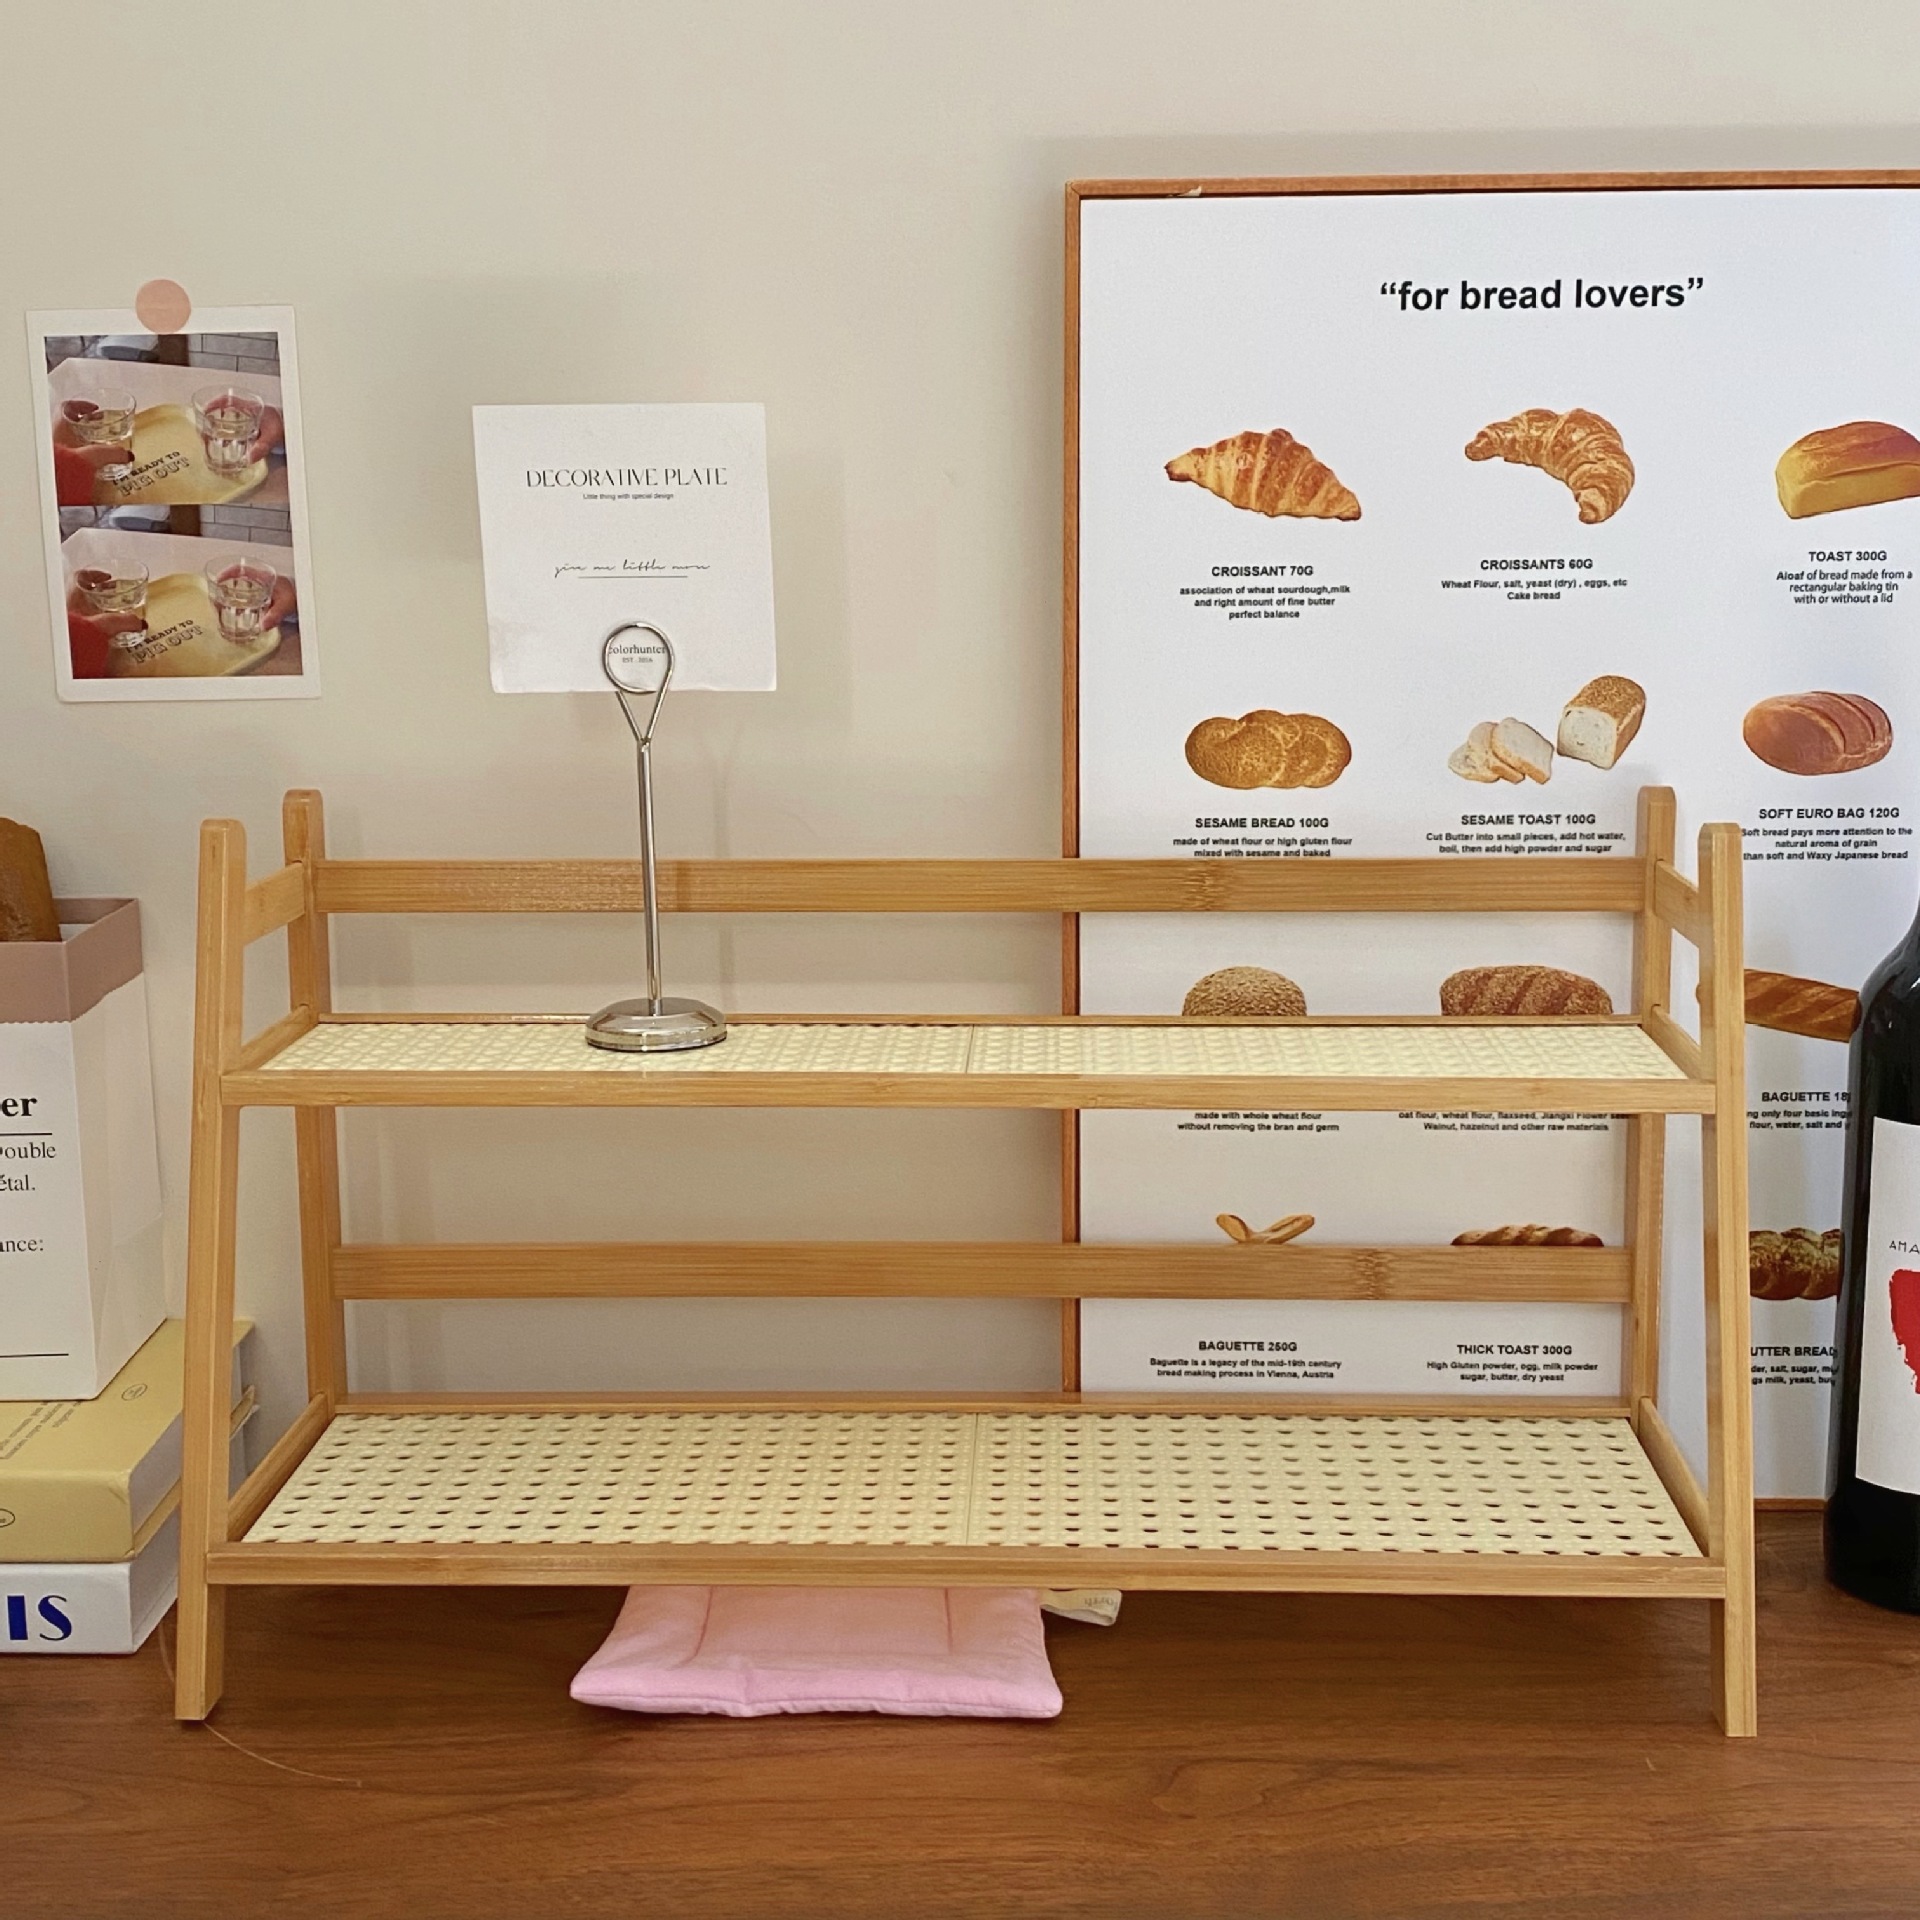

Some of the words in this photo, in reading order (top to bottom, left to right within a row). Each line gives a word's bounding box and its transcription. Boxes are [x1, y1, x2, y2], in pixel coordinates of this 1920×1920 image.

[1460, 279, 1561, 310] bread
[130, 458, 164, 476] READY
[527, 468, 658, 486] DECORATIVE
[665, 467, 727, 486] PLATE
[600, 493, 616, 501] thing
[632, 493, 652, 501] special
[654, 493, 673, 501] design
[1809, 551, 1852, 561] TOAST
[1856, 551, 1887, 561] 300G
[1480, 559, 1565, 569] CROISSANTS
[1569, 558, 1593, 569] 60G
[1212, 566, 1286, 577] CROISSANT
[1290, 565, 1314, 577] 70G
[1776, 571, 1804, 580] Aloaf
[1805, 571, 1817, 580] of
[1819, 570, 1848, 579] bread
[1849, 570, 1880, 579] made
[1881, 570, 1904, 579] from
[1907, 571, 1913, 579] a
[1441, 580, 1471, 588] Wheat
[1474, 579, 1500, 590] Flour,
[1504, 579, 1523, 590] salt,
[1526, 579, 1551, 590] yeast
[1555, 579, 1576, 589] (dry)
[1584, 580, 1610, 589] eggs,
[1613, 578, 1627, 587] etc
[1790, 582, 1846, 593] rectangular
[1849, 582, 1882, 593] baking
[1885, 582, 1899, 591] tin
[1180, 586, 1233, 594] association
[1235, 586, 1245, 594] of
[1247, 586, 1275, 594] wheat
[1278, 585, 1351, 596] sourdough,milk
[1507, 591, 1530, 600] Cake
[1534, 591, 1560, 599] bread
[1194, 598, 1212, 607] and
[1214, 598, 1236, 609] right
[1238, 598, 1273, 606] amount
[1276, 597, 1286, 606] of
[1288, 597, 1305, 606] fine
[1307, 597, 1335, 606] butter
[1794, 594, 1816, 603] with
[1818, 595, 1829, 603] or
[1831, 593, 1870, 603] without
[1872, 594, 1879, 602] a
[1881, 593, 1893, 602] lid
[1229, 610, 1261, 620] perfect
[1264, 610, 1300, 618] balance
[144, 626, 177, 644] READY
[179, 620, 194, 628] TO
[1759, 808, 1793, 819] SOFT
[1797, 808, 1833, 819] EURO
[1837, 808, 1865, 819] BAG
[1869, 808, 1899, 818] 120G
[1195, 818, 1248, 828] SESAME
[1251, 818, 1295, 828] BREAD
[1299, 818, 1330, 828] 100G
[1460, 815, 1515, 825] SESAME
[1518, 814, 1562, 825] TOAST
[1565, 814, 1596, 824] 100G
[1426, 833, 1443, 841] Cut
[1445, 833, 1474, 841] Butter
[1476, 833, 1495, 841] into
[1497, 833, 1521, 841] small
[1523, 832, 1557, 843] pieces,
[1560, 832, 1577, 840] add
[1579, 832, 1595, 840] hot
[1597, 832, 1625, 842] water,
[1763, 828, 1788, 836] bread
[1791, 829, 1813, 838] pays
[1173, 837, 1198, 846] made
[1200, 837, 1210, 846] of
[1212, 837, 1239, 846] wheat
[1241, 837, 1262, 846] flour
[1265, 838, 1274, 846] or
[1278, 837, 1297, 848] high
[1299, 837, 1330, 848] gluten
[1332, 837, 1352, 846] flour
[1776, 840, 1807, 848] natural
[1842, 839, 1851, 847] of
[1854, 839, 1877, 849] grain
[1439, 845, 1459, 855] boil,
[1462, 845, 1482, 853] then
[1485, 844, 1502, 853] add
[1505, 844, 1525, 854] high
[1528, 844, 1562, 854] powder
[1565, 844, 1582, 852] and
[1586, 845, 1612, 854] sugar
[1744, 852, 1764, 860] than
[1767, 852, 1784, 860] soft
[1787, 851, 1804, 860] and
[1807, 851, 1832, 862] Waxy
[1835, 851, 1879, 862] Japanese
[1882, 851, 1908, 859] bread
[1762, 1092, 1830, 1102] BAGUETTE
[0, 1097, 38, 1117] er
[1178, 1123, 1210, 1131] without
[1213, 1123, 1255, 1133] removing
[1258, 1123, 1271, 1131] the
[1274, 1123, 1294, 1131] bran
[1297, 1123, 1313, 1131] and
[1316, 1125, 1339, 1133] germ
[0, 1142, 57, 1159] ouble
[1199, 1341, 1264, 1351] BAGUETTE
[1268, 1341, 1297, 1351] 250G
[1456, 1345, 1494, 1354] THICK
[1497, 1345, 1539, 1355] TOAST
[1542, 1345, 1572, 1355] 300G
[1427, 1362, 1448, 1371] High
[1482, 1362, 1518, 1371] powder,
[1520, 1364, 1541, 1372] egg,
[1564, 1363, 1598, 1372] powder
[1491, 1374, 1519, 1383] butter,
[1522, 1374, 1536, 1383] dry
[1539, 1374, 1564, 1383] yeast
[7, 1595, 73, 1640] IS
